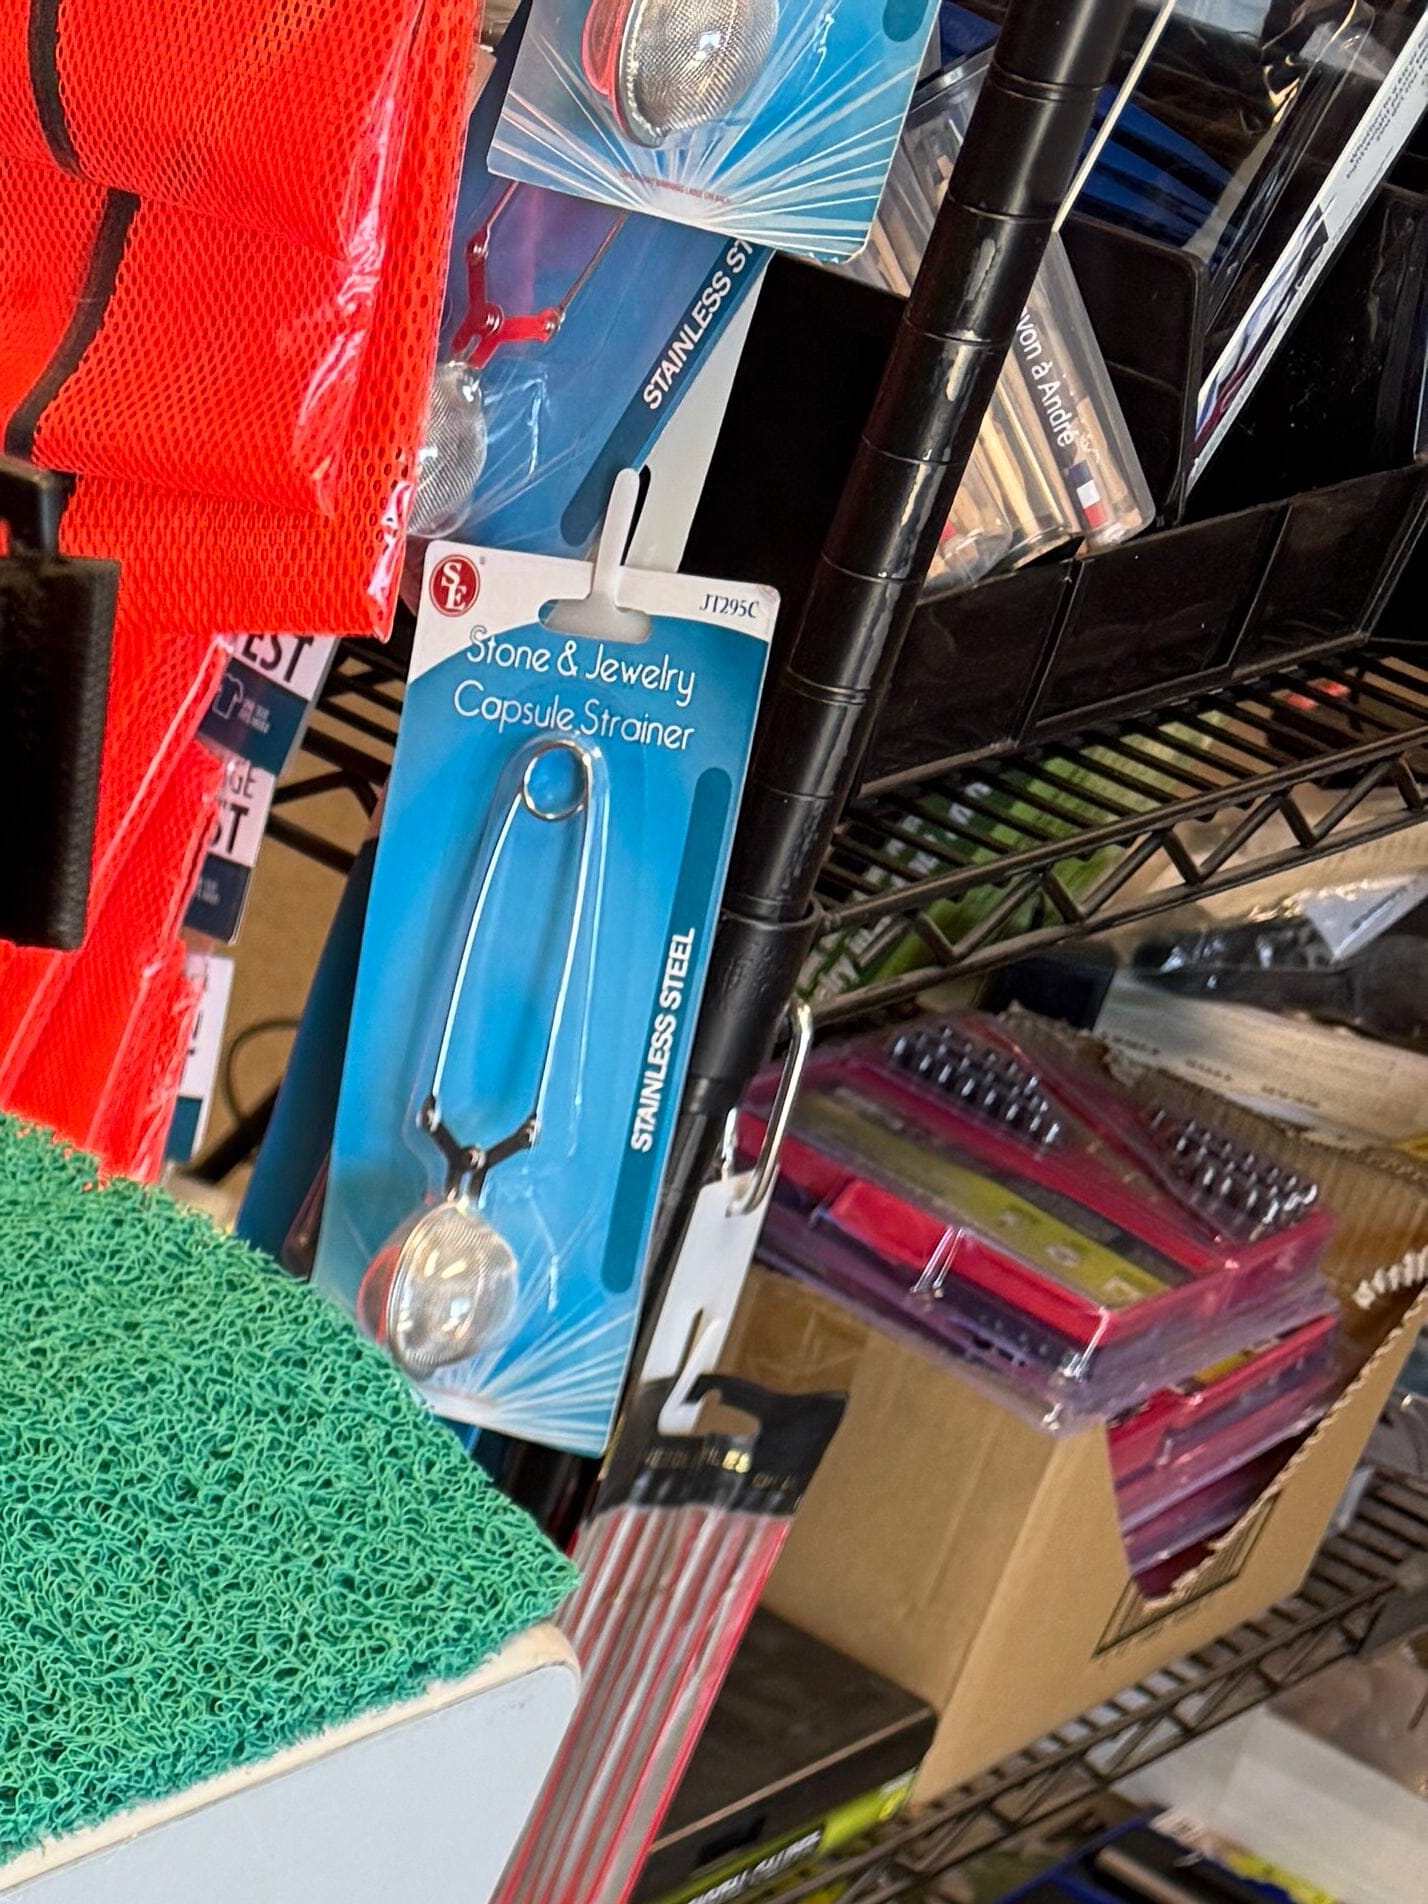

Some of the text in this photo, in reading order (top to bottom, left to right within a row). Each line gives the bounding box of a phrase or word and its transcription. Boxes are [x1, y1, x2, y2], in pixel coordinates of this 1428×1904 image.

[643, 269, 732, 411] STAINLESS
[1016, 308, 1080, 448] von à André
[698, 592, 760, 620] JT295C
[453, 679, 696, 751] Capsule Strainer
[466, 625, 696, 708] Stone & Jewelry
[630, 926, 695, 1153] STAINLESS STEEL
